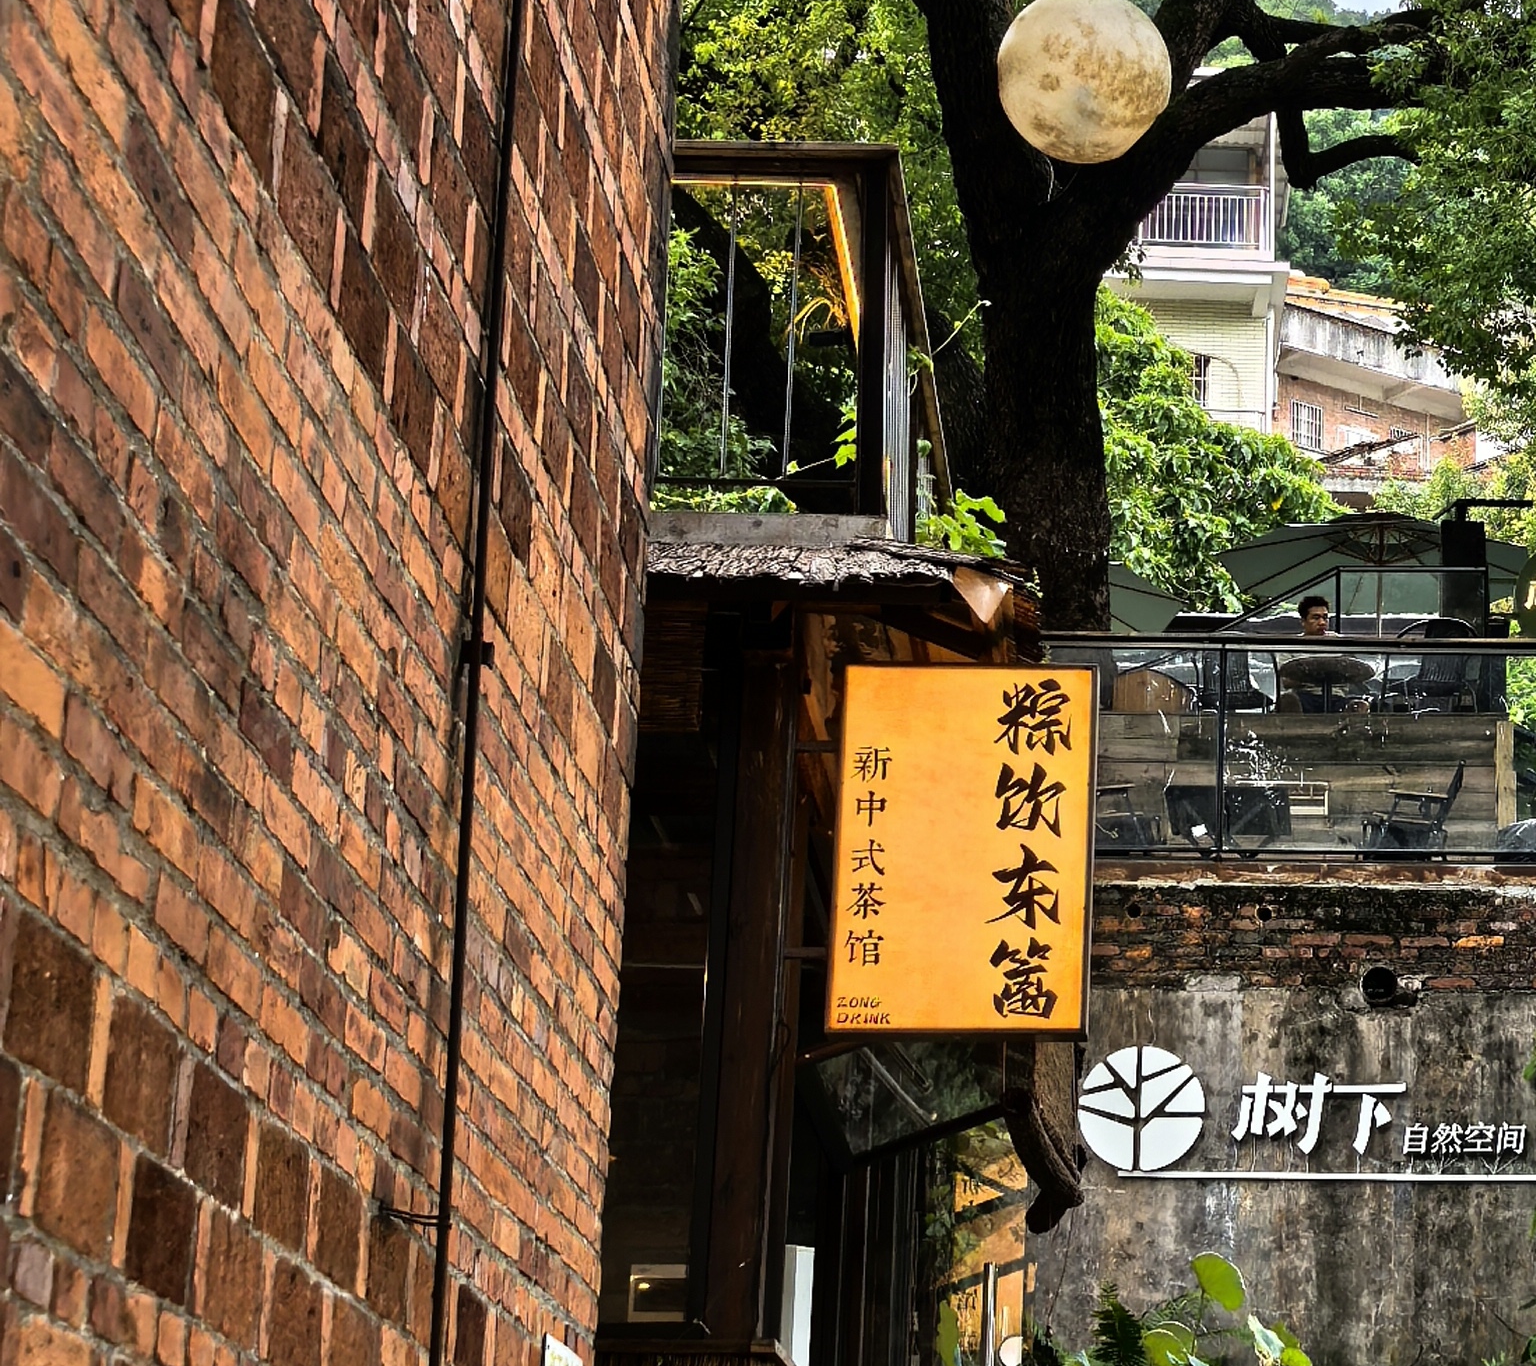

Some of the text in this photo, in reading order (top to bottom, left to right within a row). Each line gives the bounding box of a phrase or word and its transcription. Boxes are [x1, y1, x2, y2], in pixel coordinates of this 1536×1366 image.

[844, 745, 893, 967] 新中式茶馆
[984, 678, 1073, 1019] 粽饮东篱
[837, 996, 882, 1008] ZONG
[837, 1012, 890, 1025] DRINK
[1231, 1071, 1527, 1155] 树下 自然空间
